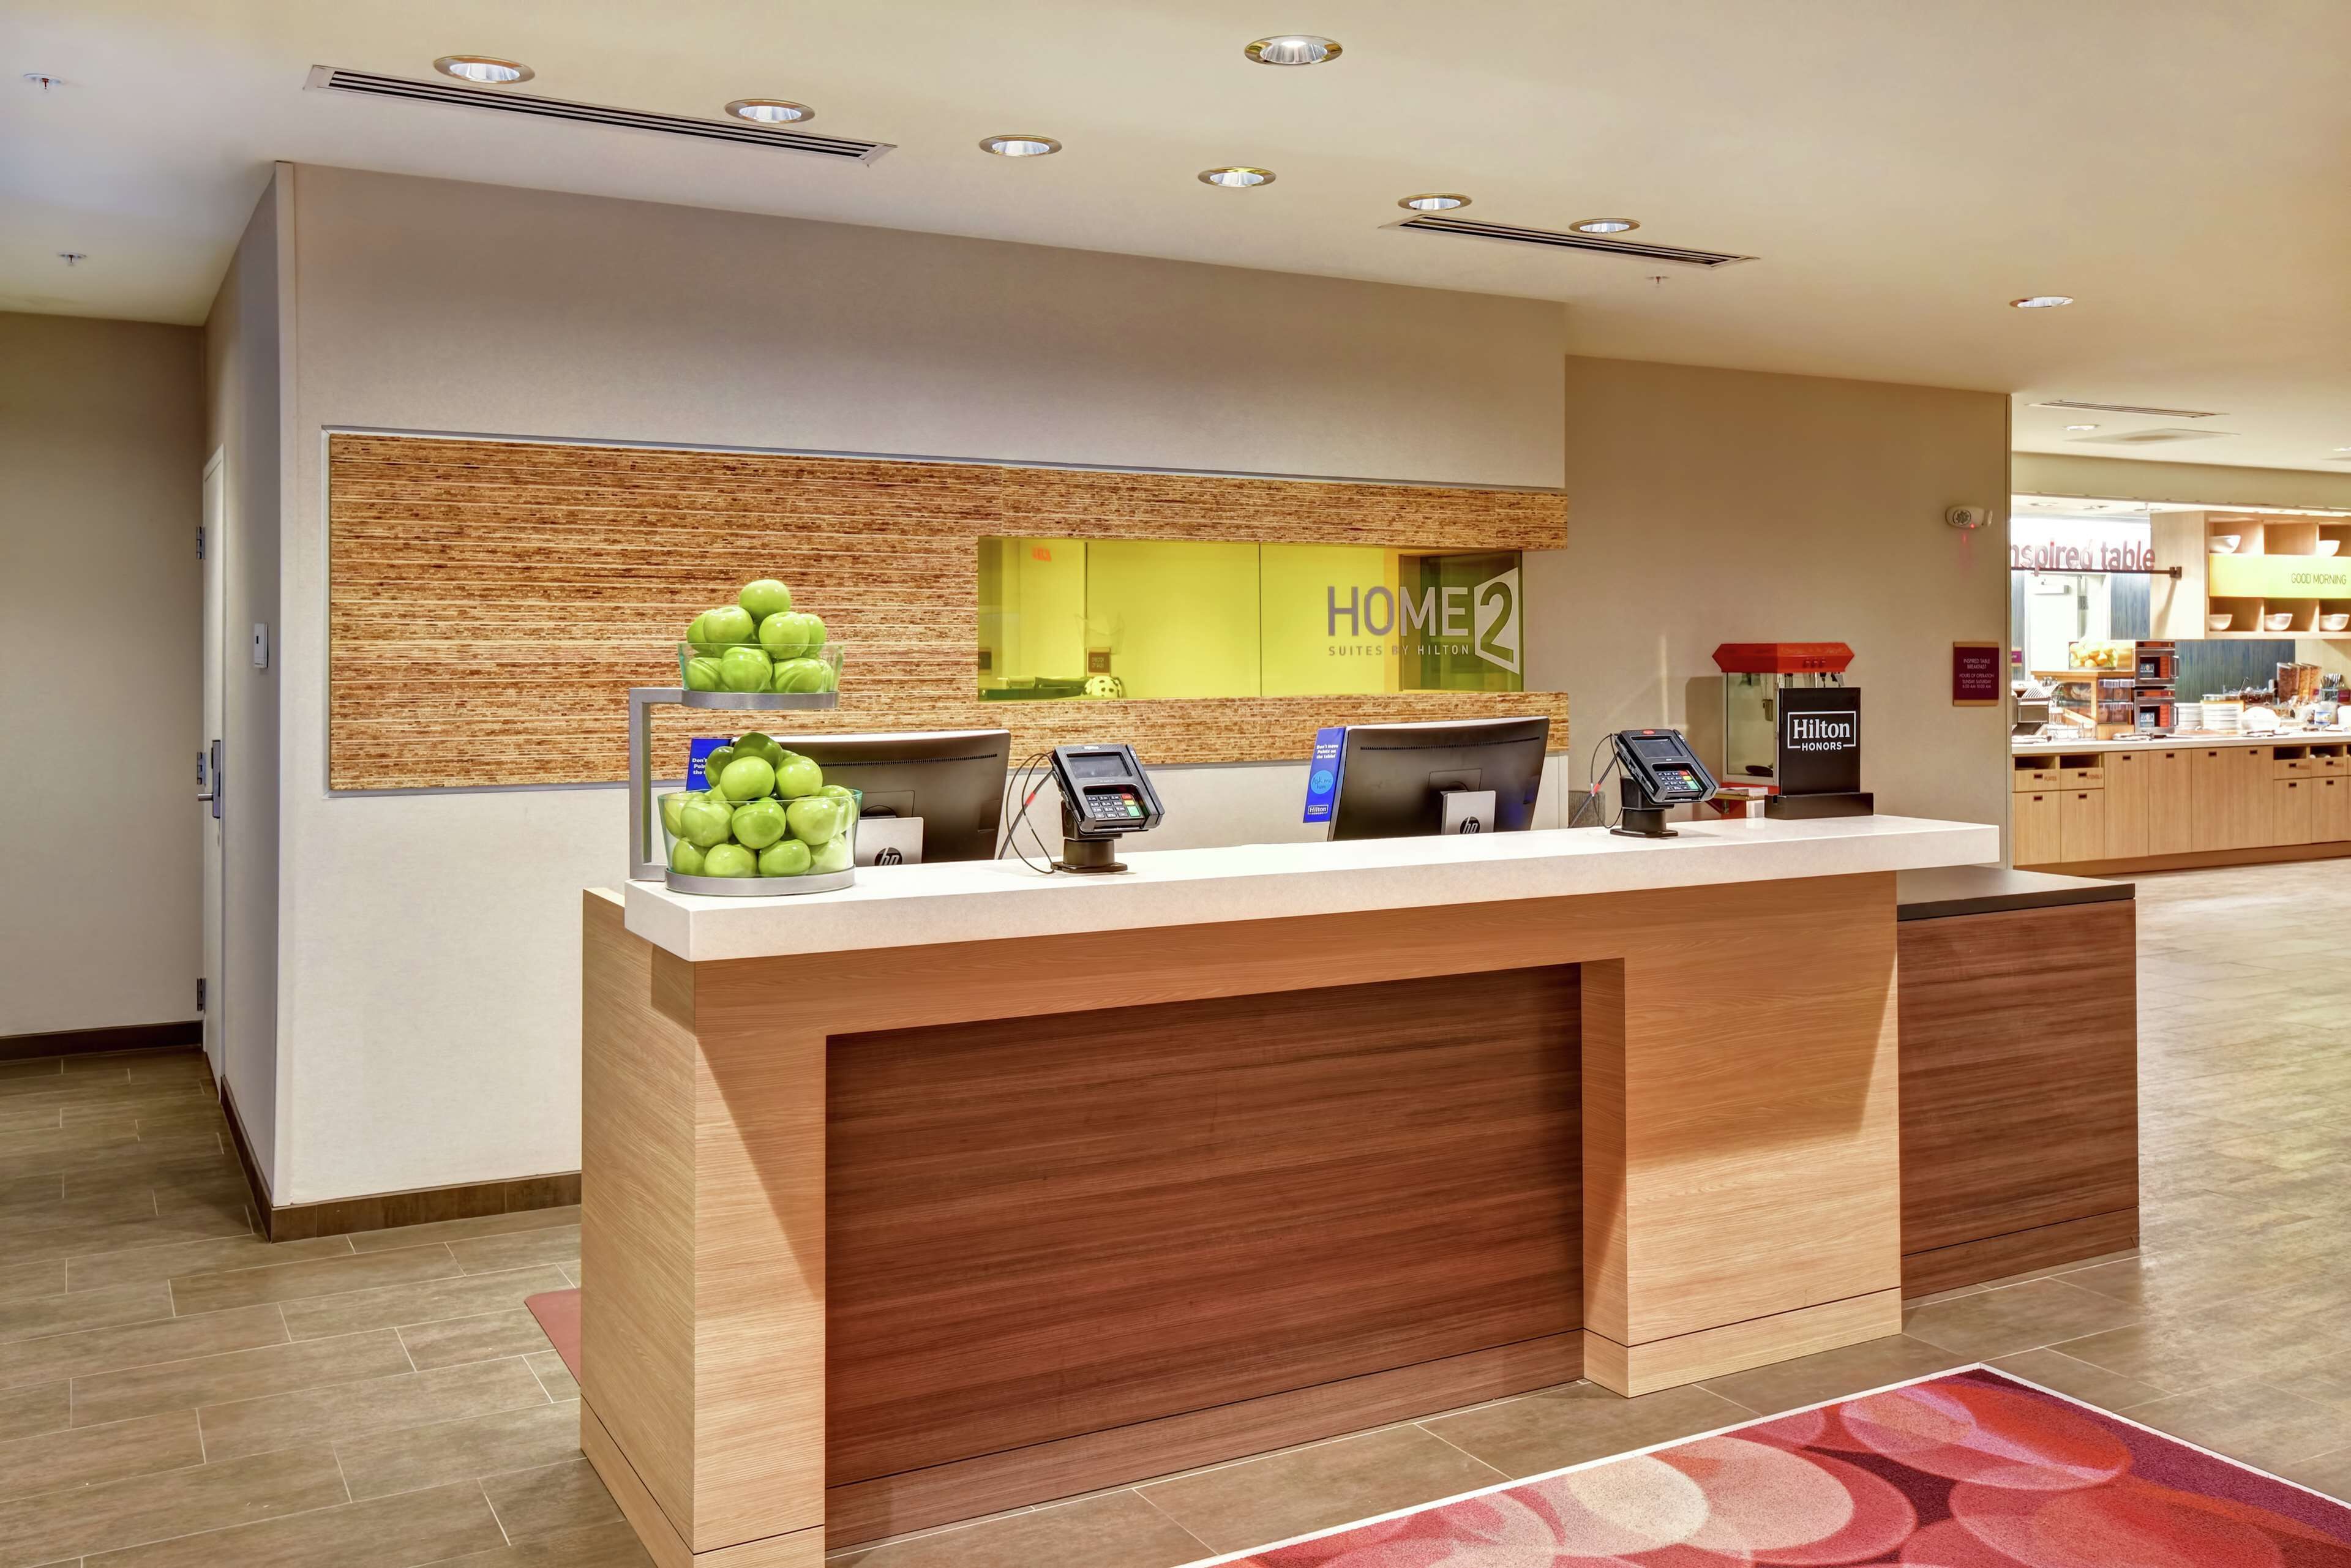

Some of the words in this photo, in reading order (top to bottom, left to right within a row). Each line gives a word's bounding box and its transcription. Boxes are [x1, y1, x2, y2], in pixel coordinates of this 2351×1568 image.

[2011, 539, 2093, 576] nspired
[2101, 540, 2156, 571] table
[2292, 573, 2311, 584] GOOD
[2313, 573, 2347, 585] MORNING
[1329, 646, 1382, 656] SUITES
[1392, 646, 1408, 655] BY
[1417, 645, 1469, 655] HILTON
[1793, 719, 1850, 739] Hilton
[1802, 742, 1842, 751] HONORS
